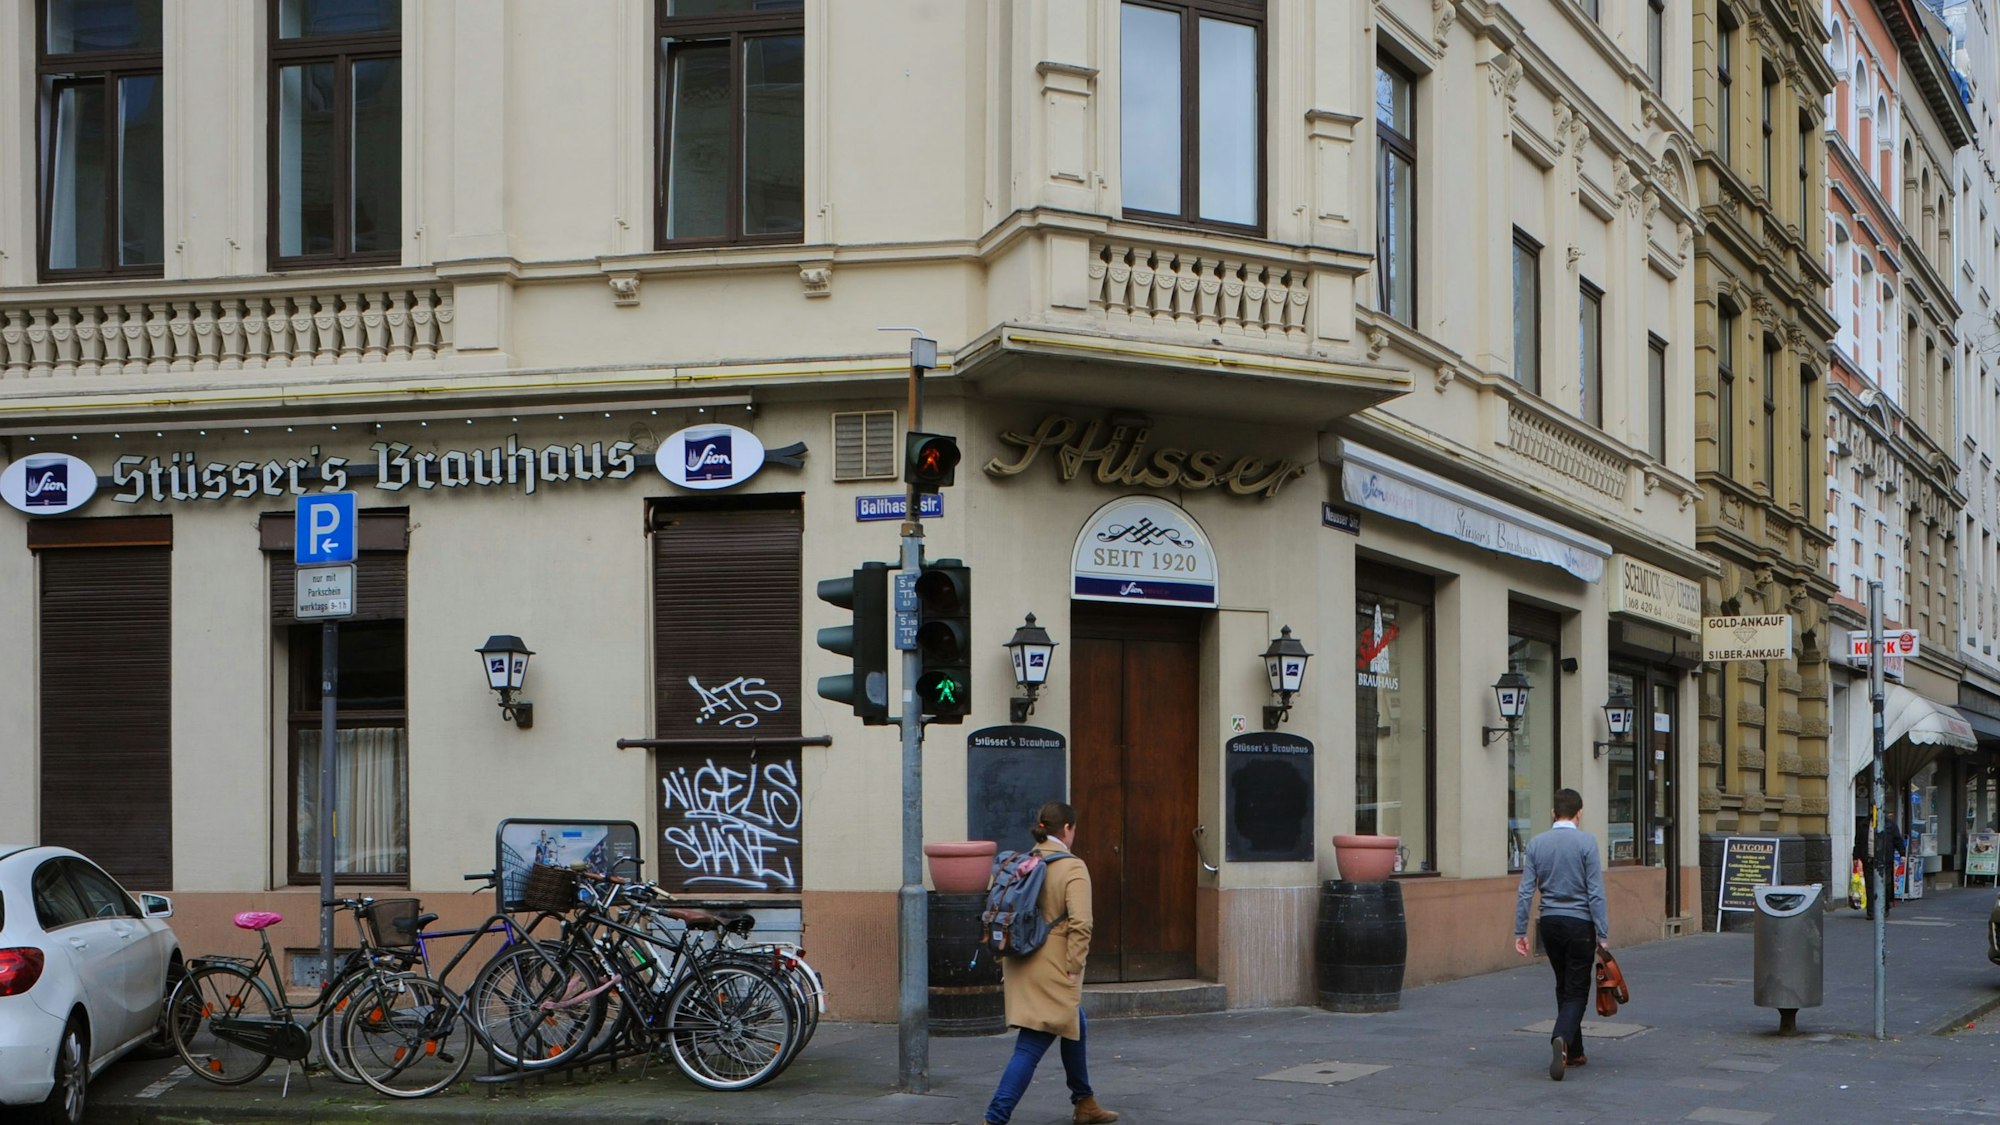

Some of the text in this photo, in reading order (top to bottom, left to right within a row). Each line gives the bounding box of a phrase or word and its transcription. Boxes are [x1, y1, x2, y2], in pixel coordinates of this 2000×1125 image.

[112, 432, 637, 503] Stüsser's Brauhaus
[686, 443, 731, 472] Sion
[26, 471, 67, 497] Sion
[309, 503, 340, 555] P
[1094, 548, 1196, 572] SEIT 1920
[1625, 562, 1661, 600] SCHMUCK
[1709, 616, 1784, 628] GOLD-ANKAUF
[1709, 648, 1785, 660] SILBER-ANKAUF
[1358, 672, 1399, 690] BRAUHAUS
[1019, 737, 1060, 749] Brauhaus
[1731, 844, 1773, 852] ALTGOLD
